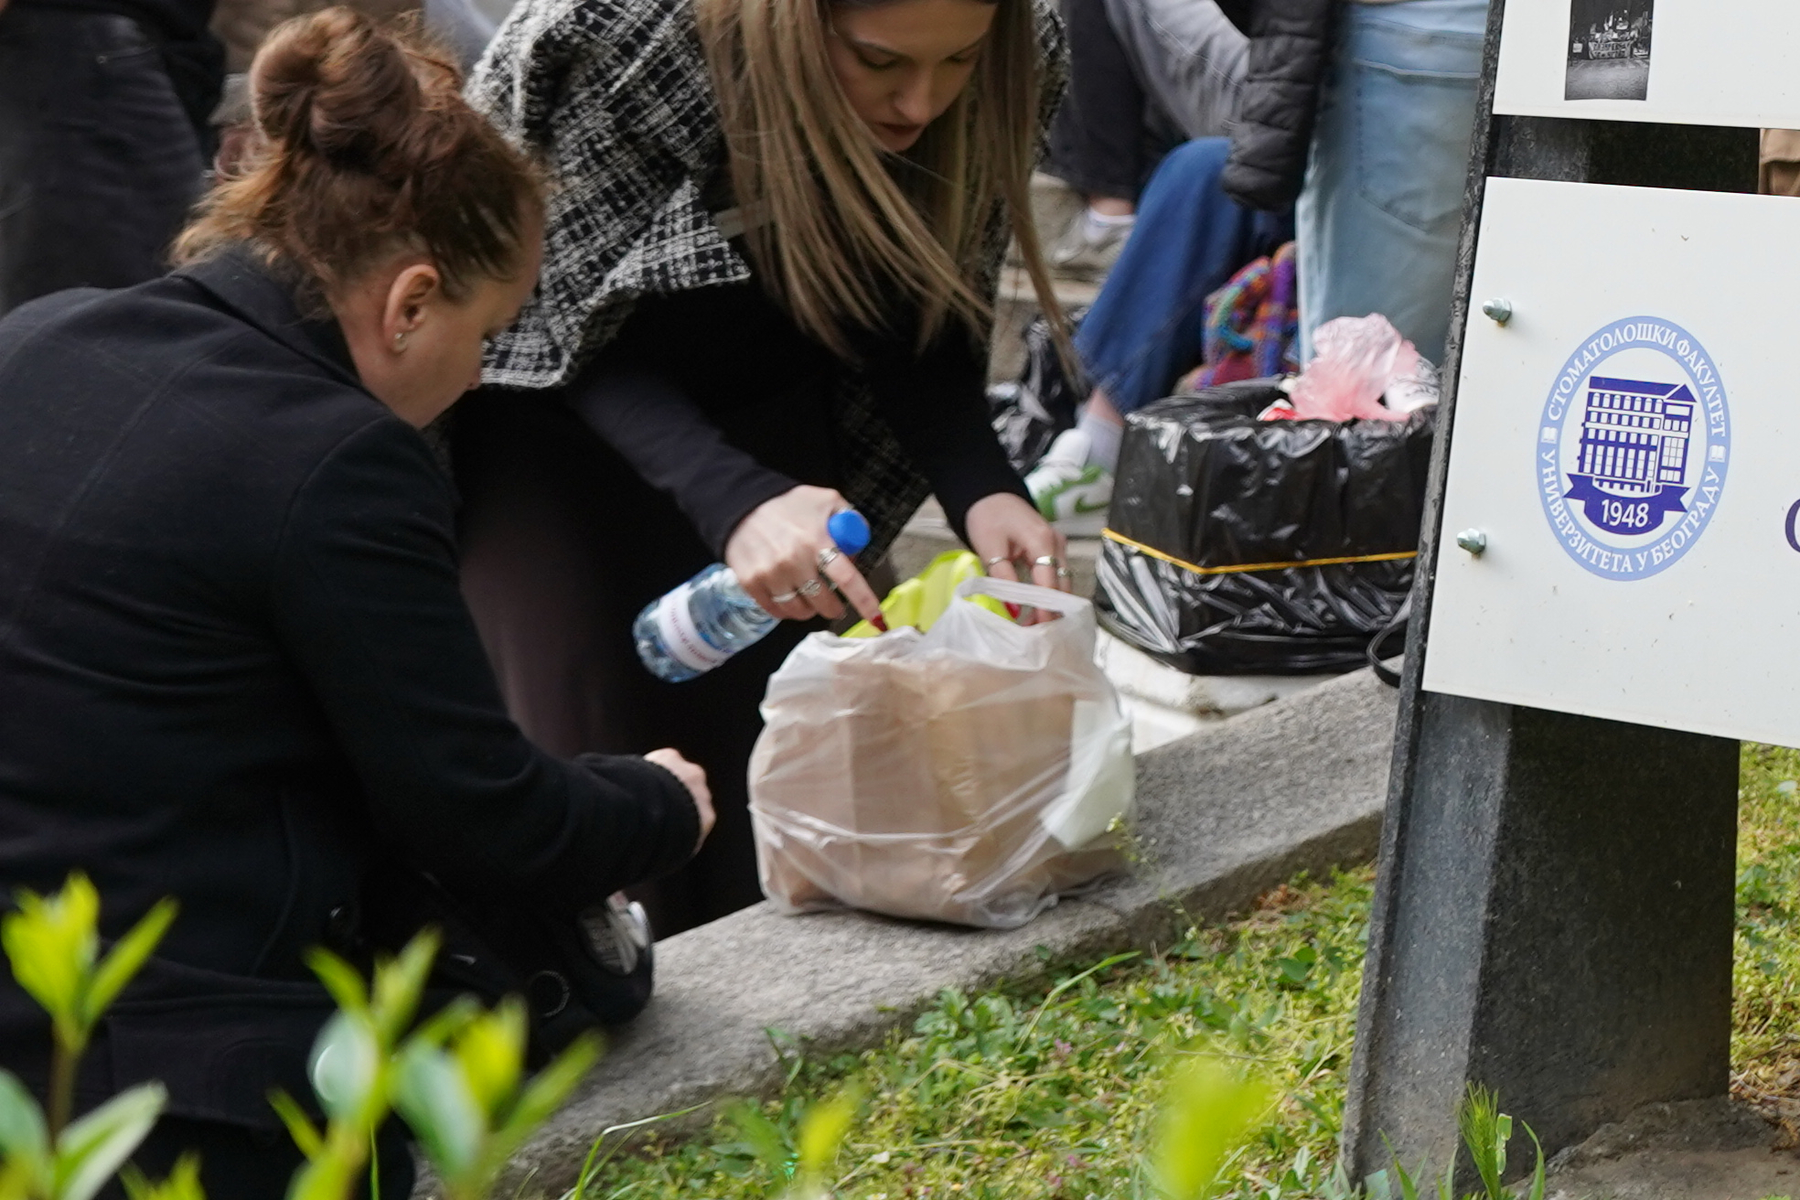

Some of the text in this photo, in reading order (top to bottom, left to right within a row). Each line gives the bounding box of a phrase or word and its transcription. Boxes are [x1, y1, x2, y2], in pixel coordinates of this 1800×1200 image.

[1547, 322, 1727, 438] СТОМАТОЛОШКИ ФАКУЛТЕТ
[1541, 449, 1721, 573] УНИВЕРЗИТЕТА У БЕОГРАДУ
[1601, 498, 1650, 529] 1948
